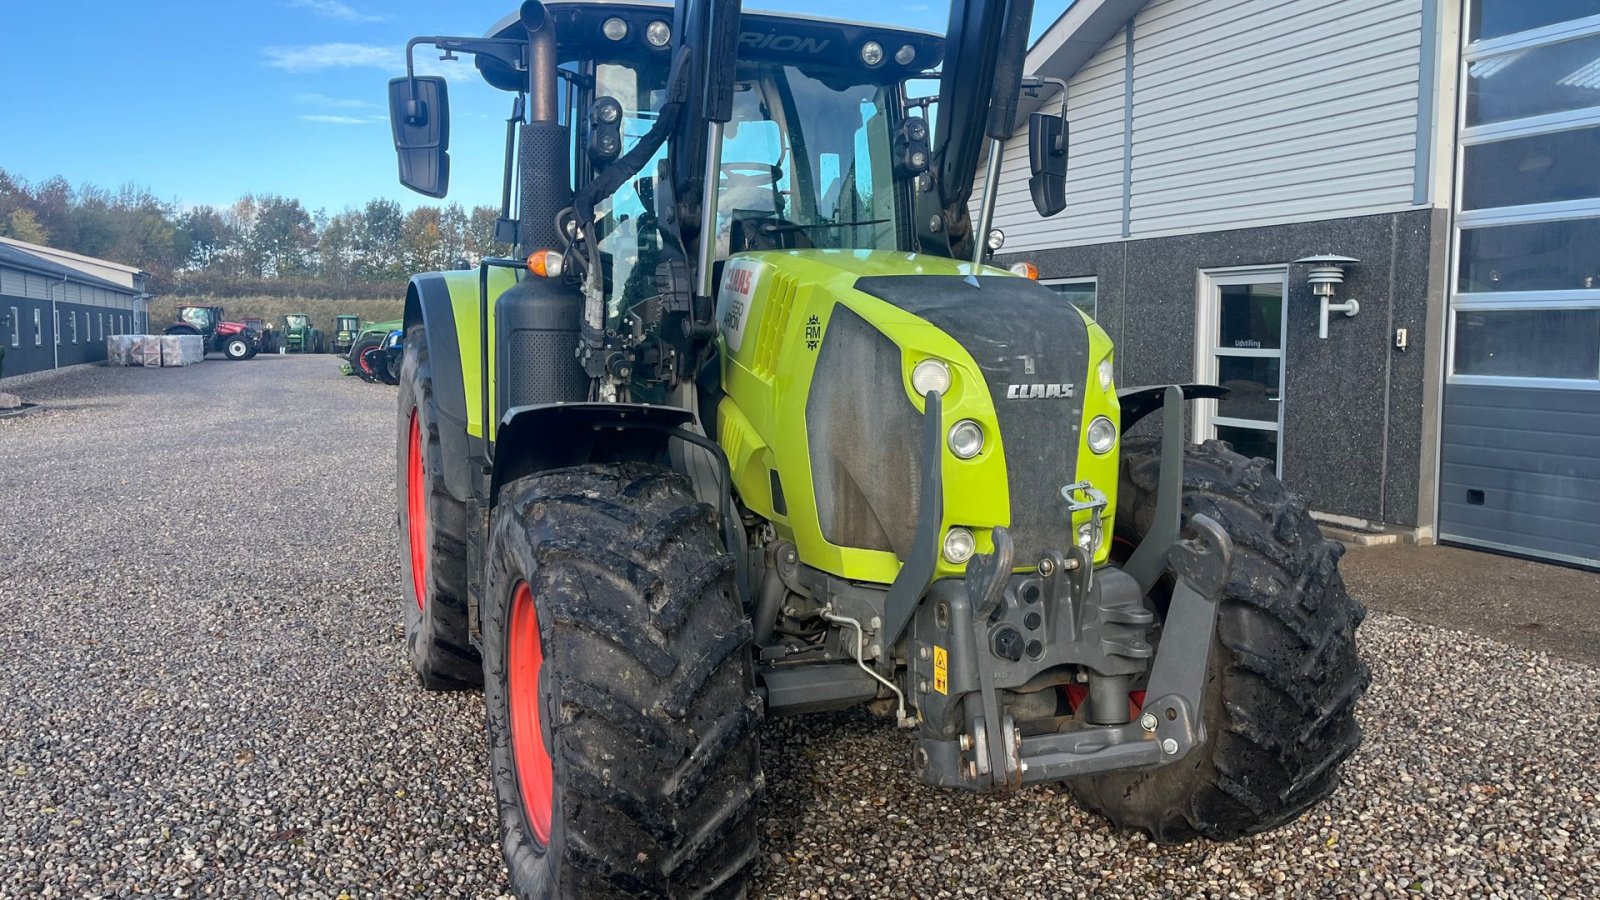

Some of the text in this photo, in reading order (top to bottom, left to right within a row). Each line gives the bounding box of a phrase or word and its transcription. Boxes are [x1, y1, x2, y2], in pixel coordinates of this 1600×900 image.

[739, 31, 832, 53] RION
[805, 326, 821, 340] RM
[1234, 339, 1261, 349] Udstilling
[1007, 383, 1074, 399] CLAAS
